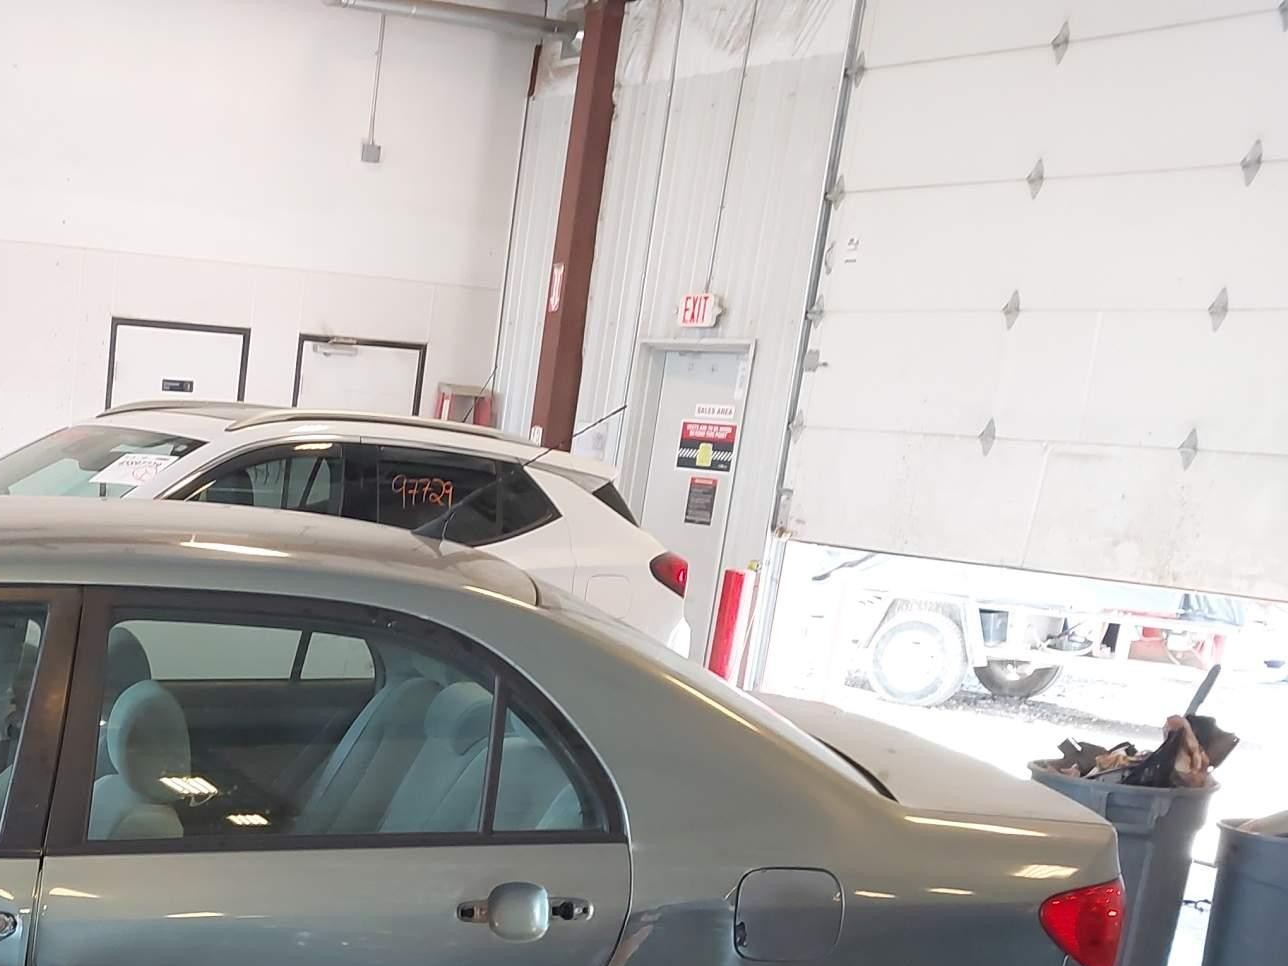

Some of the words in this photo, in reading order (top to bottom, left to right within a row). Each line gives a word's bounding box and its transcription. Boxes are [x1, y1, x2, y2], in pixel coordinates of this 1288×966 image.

[682, 295, 710, 323] EXIT
[716, 407, 733, 416] AREA
[392, 474, 453, 512] 97729
